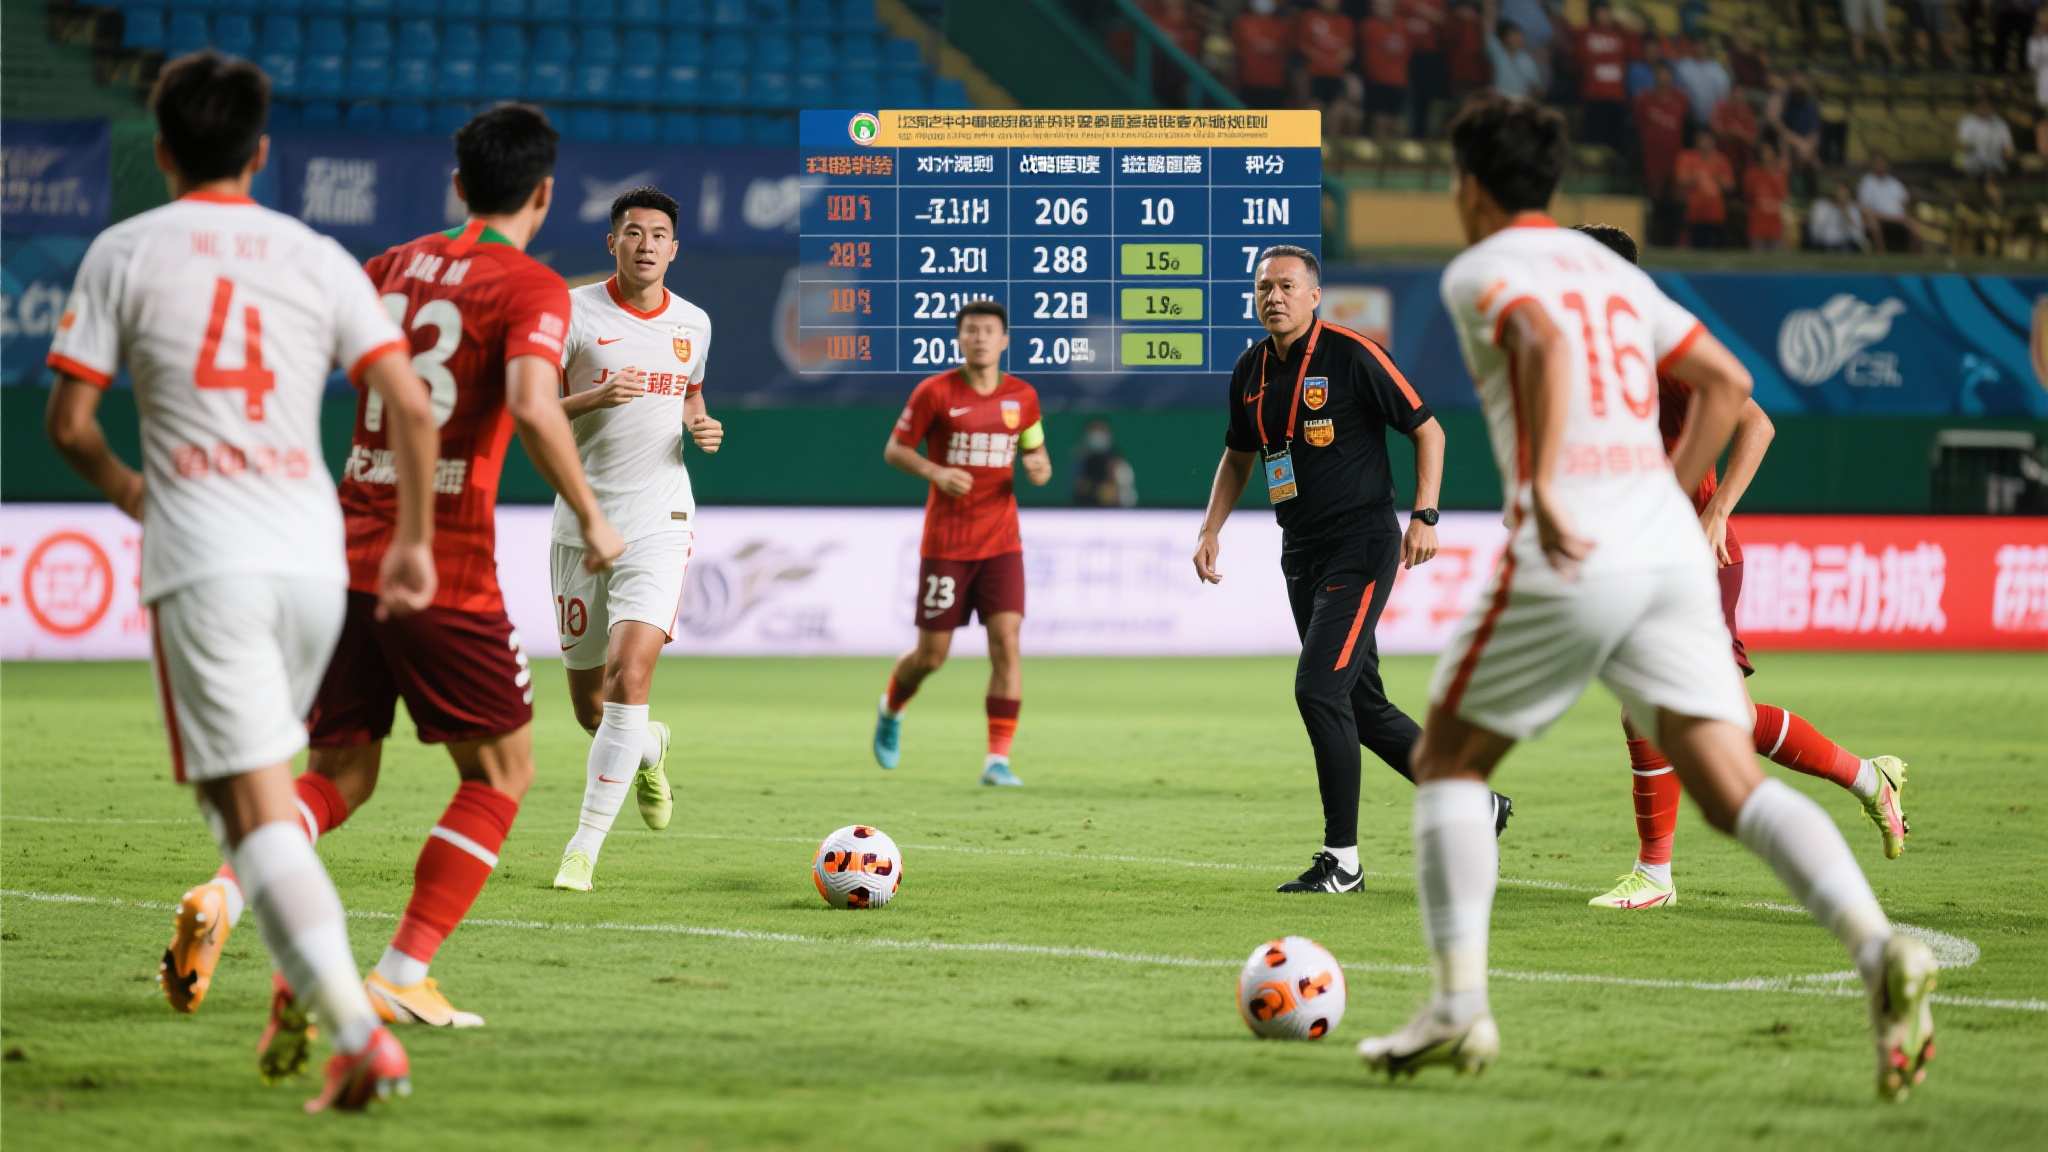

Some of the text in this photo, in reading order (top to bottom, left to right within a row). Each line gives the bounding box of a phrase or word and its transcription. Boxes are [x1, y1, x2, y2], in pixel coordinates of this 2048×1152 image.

[1035, 197, 1089, 225] 206
[1141, 197, 1175, 225] 10
[1033, 246, 1088, 273] 288
[194, 276, 276, 422] 4
[1562, 291, 1658, 420] 16
[924, 574, 956, 609] 23
[557, 594, 588, 637] 10
